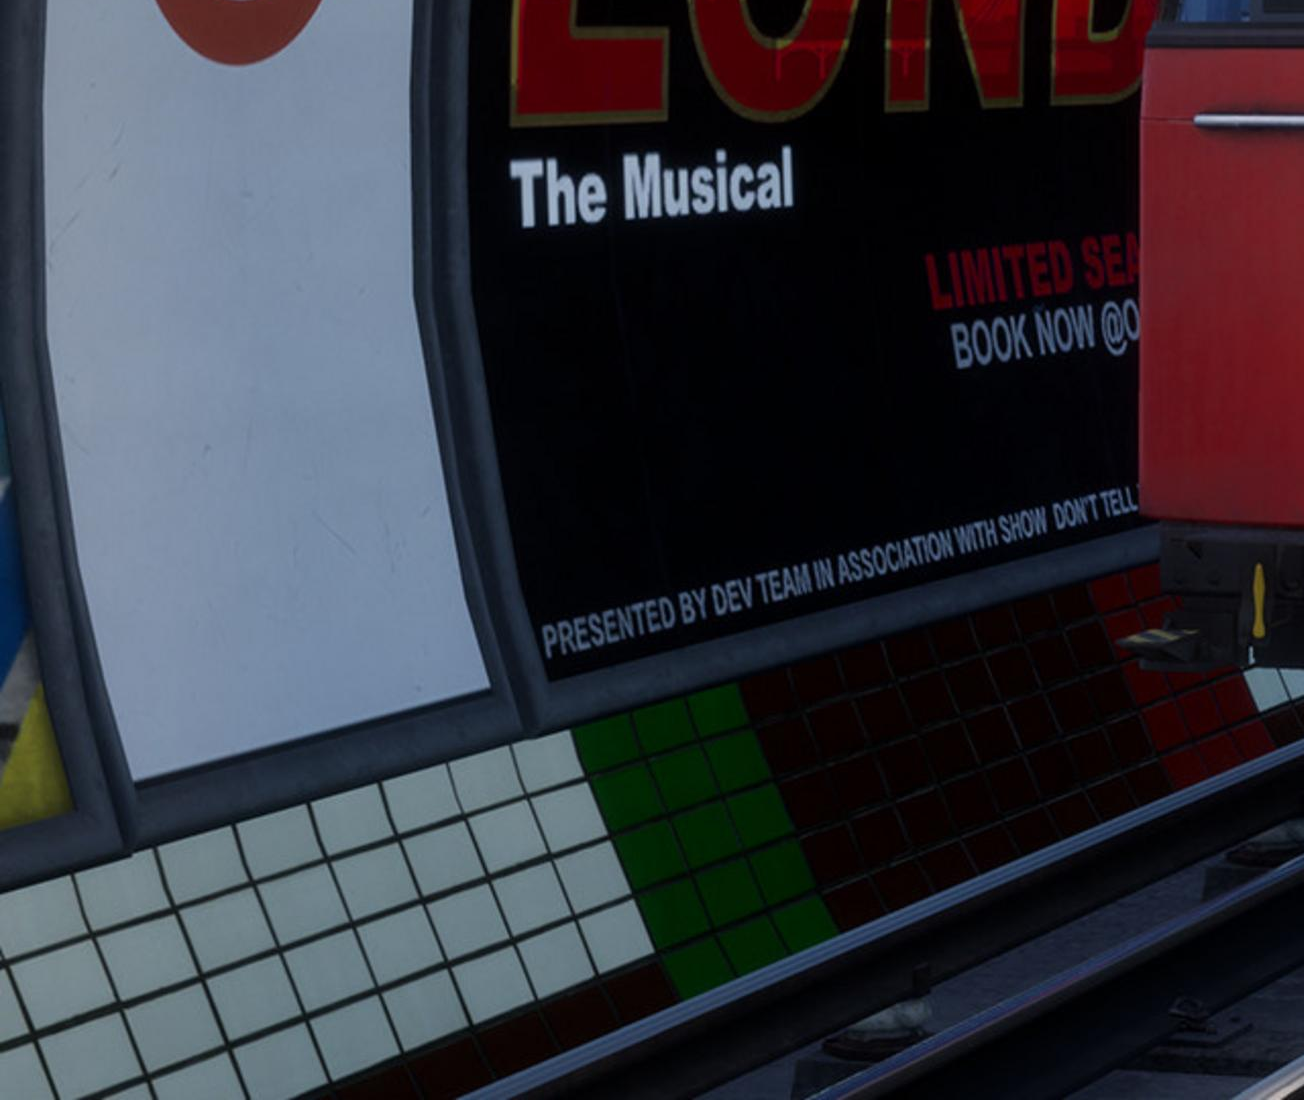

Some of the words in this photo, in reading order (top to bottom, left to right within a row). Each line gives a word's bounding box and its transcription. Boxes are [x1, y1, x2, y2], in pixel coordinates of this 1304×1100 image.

[510, 157, 607, 228] The
[622, 146, 794, 220] Musical
[924, 240, 1074, 311] LIMITED
[950, 313, 1033, 369] BOOK
[1034, 304, 1096, 356] NOW
[542, 596, 676, 659] PRESENTED
[678, 586, 708, 624] BY
[711, 577, 753, 617] DEV
[755, 562, 813, 604] TEAM
[812, 558, 835, 591] IN
[837, 529, 954, 585] ASSOCIATION
[953, 518, 999, 554] WITH
[999, 505, 1048, 544] SHOW
[1052, 493, 1099, 531] DON'T
[1099, 485, 1139, 518] TELL
